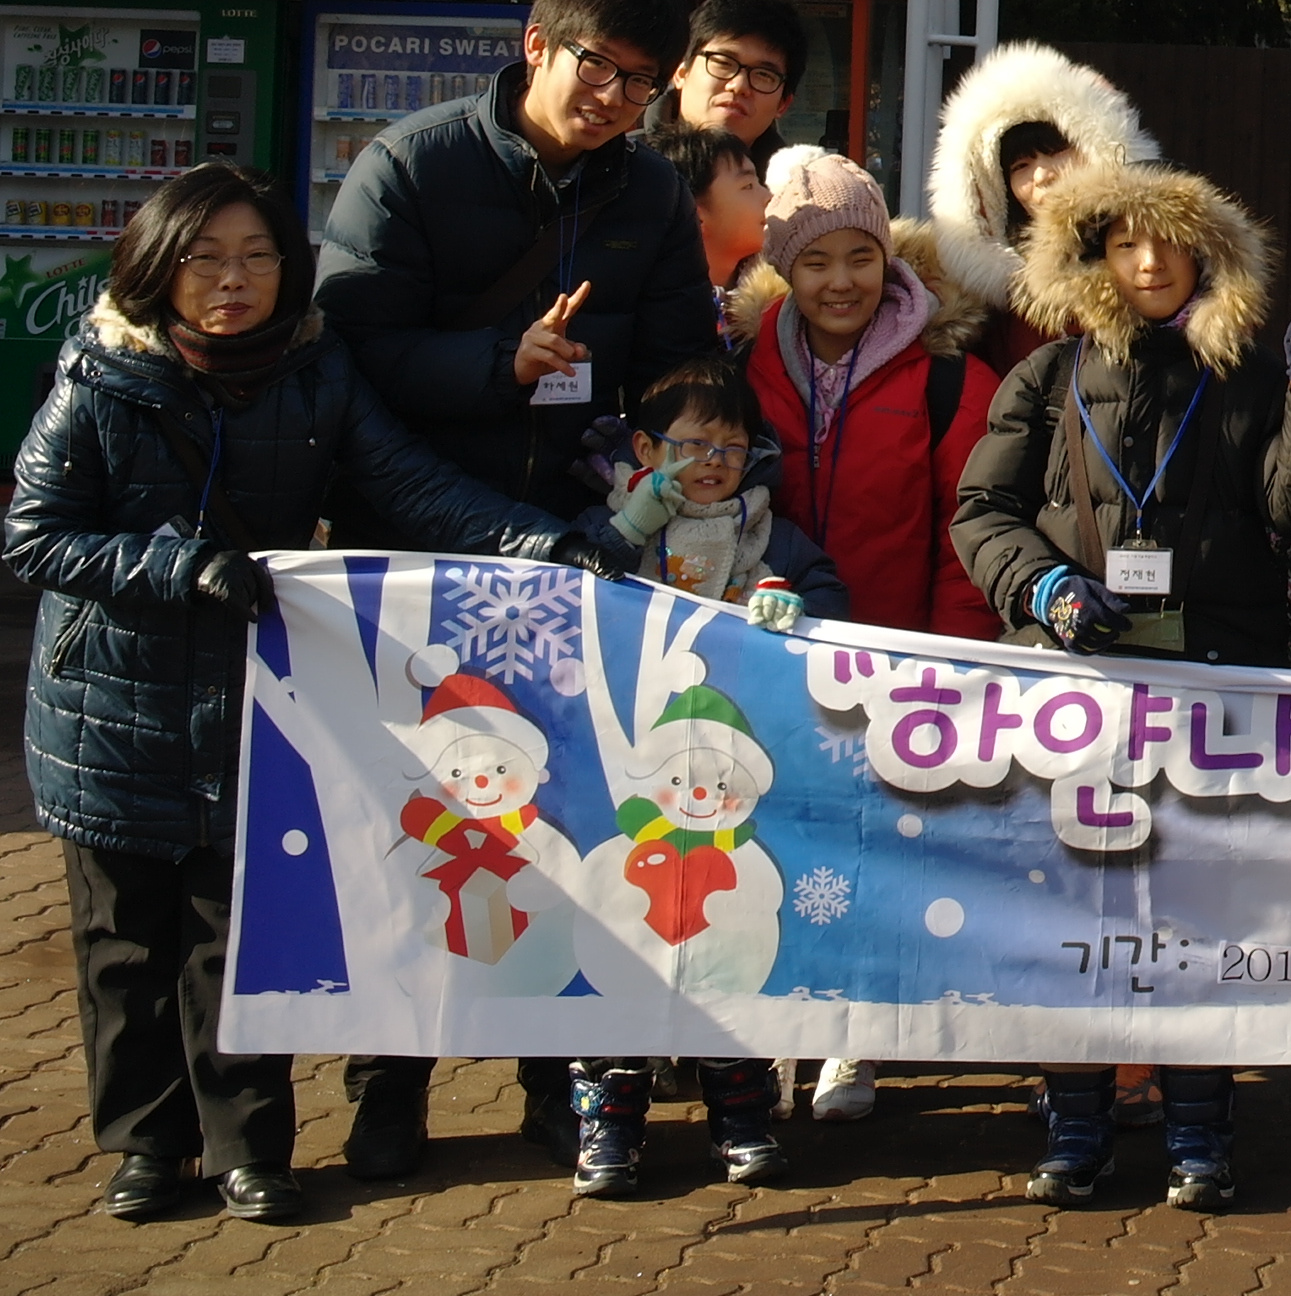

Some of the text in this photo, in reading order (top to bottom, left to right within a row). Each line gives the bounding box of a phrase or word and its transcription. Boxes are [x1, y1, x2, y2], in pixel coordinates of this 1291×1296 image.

[222, 9, 257, 18] LOTTE
[163, 44, 192, 55] pepsi
[334, 35, 522, 57] POCARI SWEAT
[46, 258, 86, 279] LOTTE
[1061, 932, 1189, 994] 기간:
